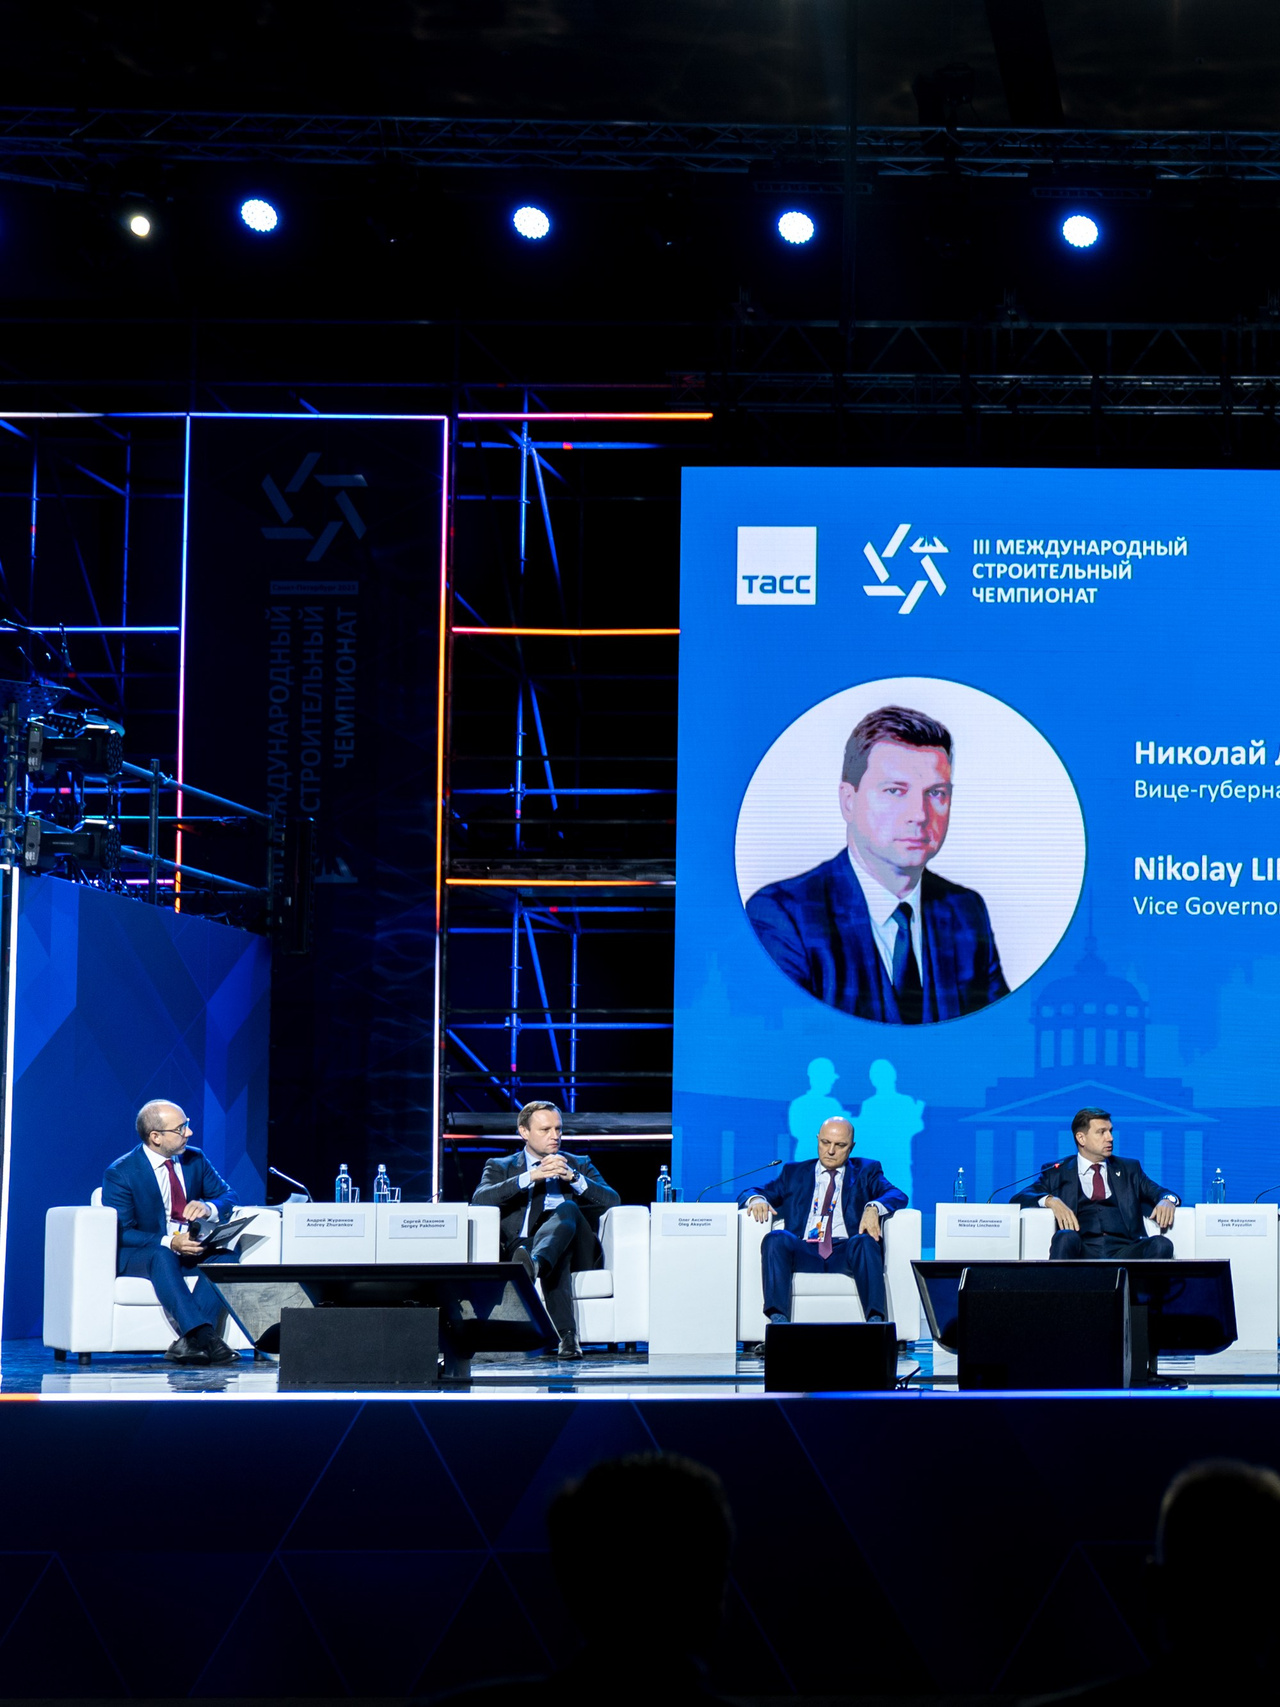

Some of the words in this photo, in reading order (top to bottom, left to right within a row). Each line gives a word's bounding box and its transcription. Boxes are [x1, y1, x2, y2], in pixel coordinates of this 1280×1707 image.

[973, 539, 990, 555] III
[996, 536, 1188, 558] МЕЖДУНАРОДНЫЙ
[972, 560, 1132, 580] СТРОИТЕЛЬНЫЙ
[972, 587, 1098, 604] ЧЕМПИОНАТ
[332, 605, 358, 769] ЧЕМПИОНАТ
[297, 605, 325, 813] СТРОИТЕЛЬНЫЙ
[1135, 739, 1266, 766] Николай
[1134, 855, 1243, 888] Nikolay
[1133, 896, 1178, 915] Vice
